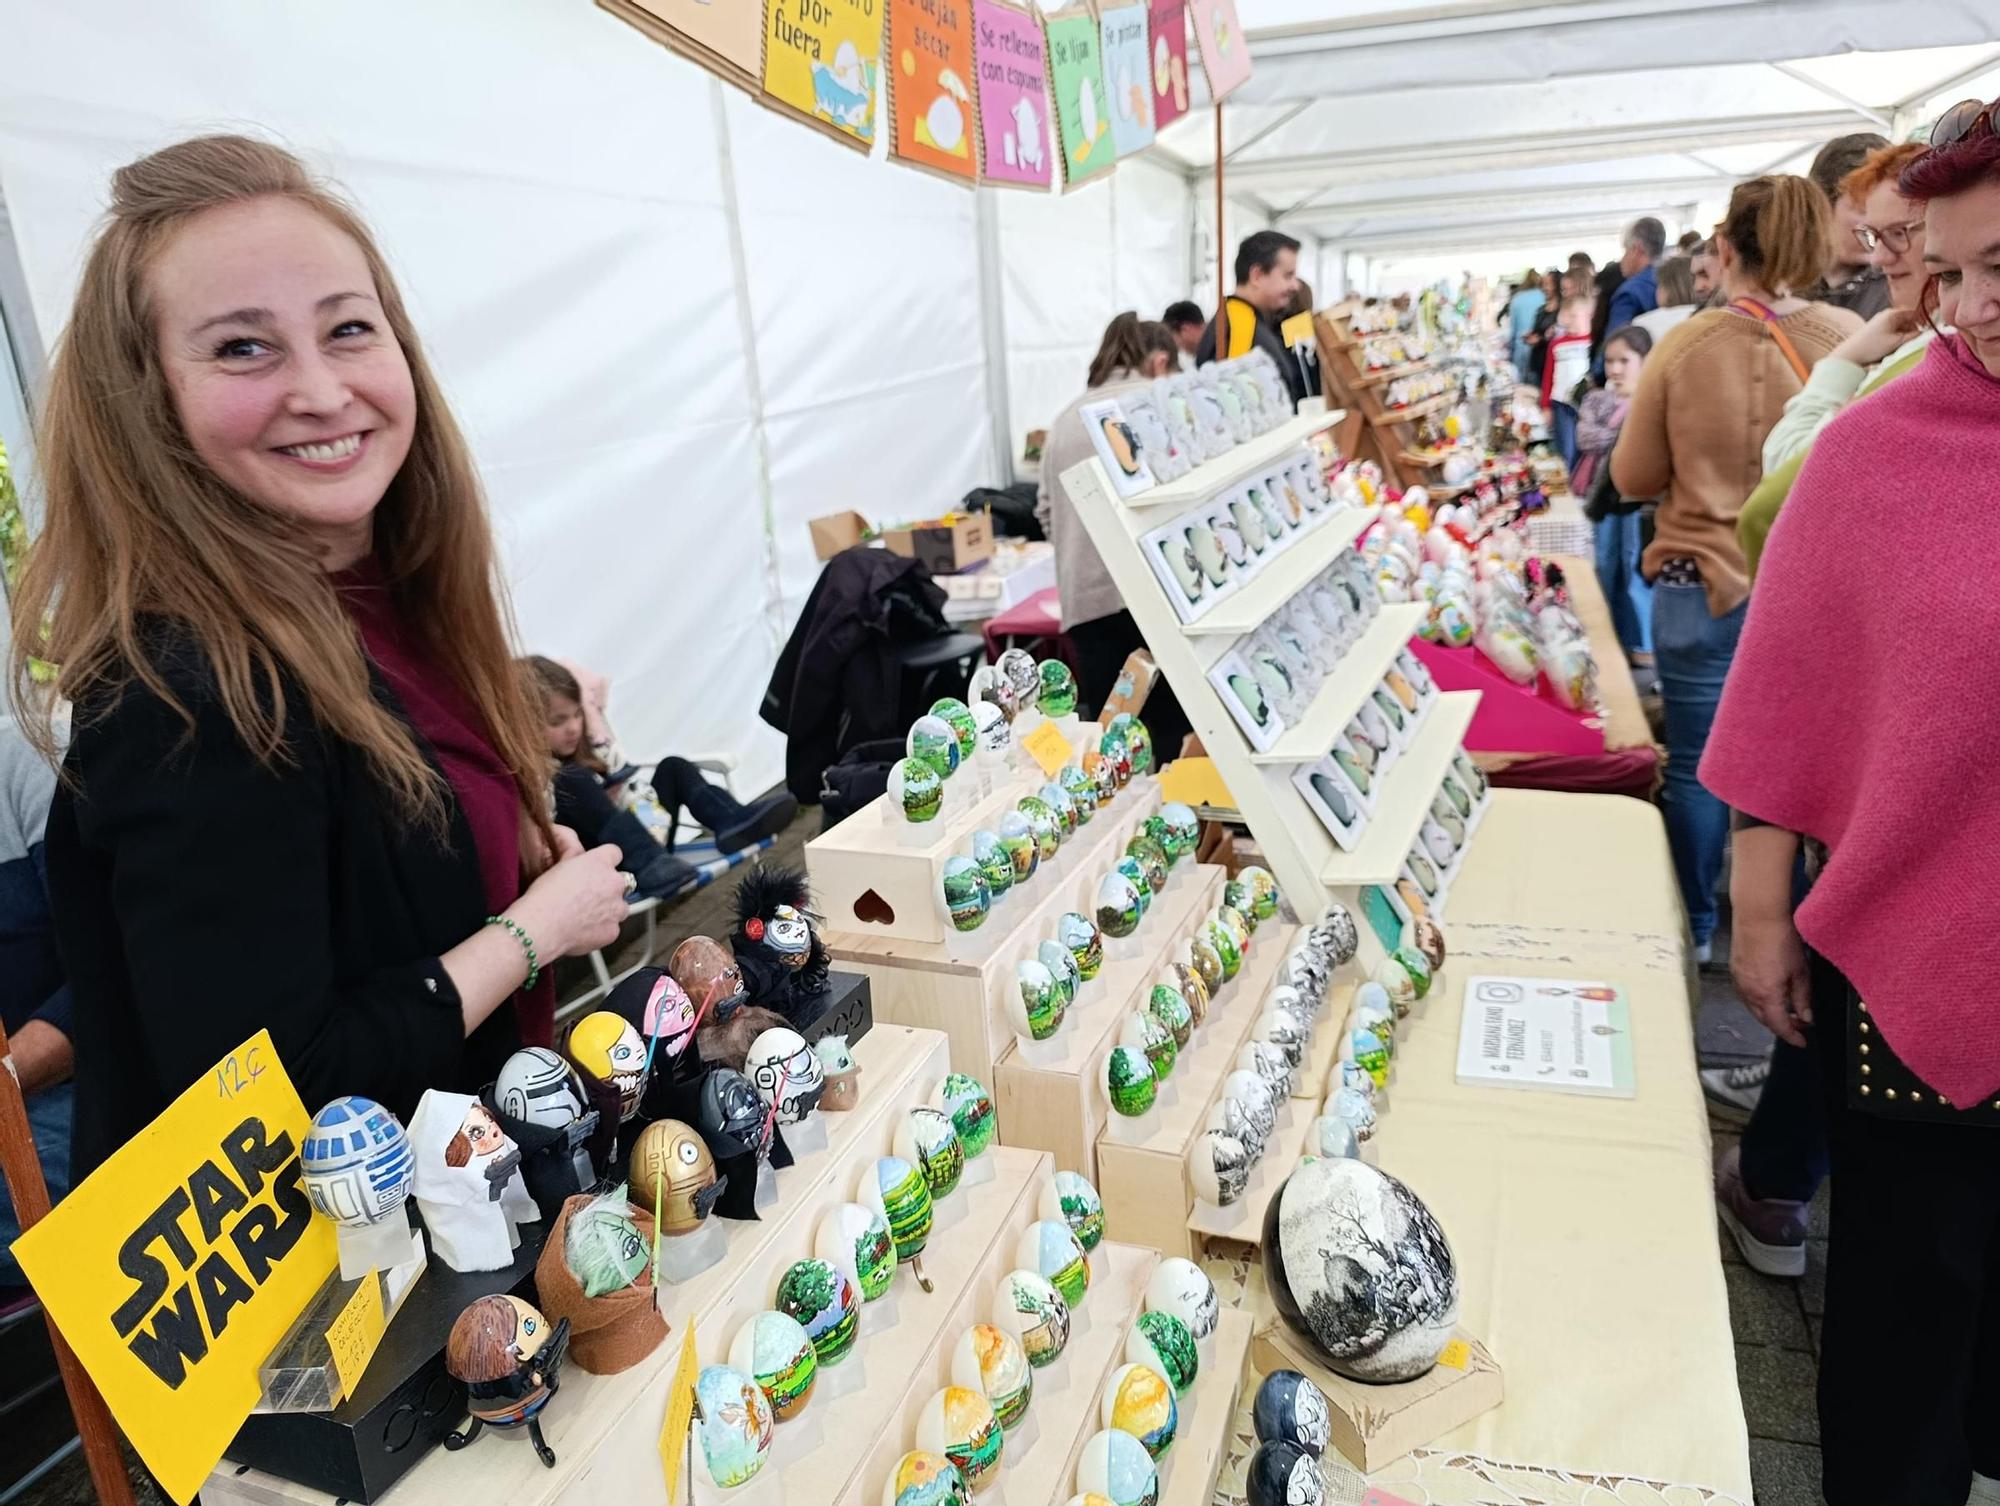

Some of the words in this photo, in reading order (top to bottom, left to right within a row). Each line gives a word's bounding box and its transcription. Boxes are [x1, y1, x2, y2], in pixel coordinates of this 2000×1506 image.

[799, 0, 832, 27] por
[774, 8, 822, 60] fuera
[914, 26, 951, 62] secar
[980, 20, 995, 48] Se
[999, 30, 1042, 60] rellenan
[1055, 40, 1068, 66] Se
[981, 59, 1005, 83] con
[1482, 1024, 1503, 1059] MARIANA
[1502, 1018, 1526, 1061] FERNÁNDEZ
[110, 1116, 296, 1339] STAR
[128, 1155, 313, 1391] WARS
